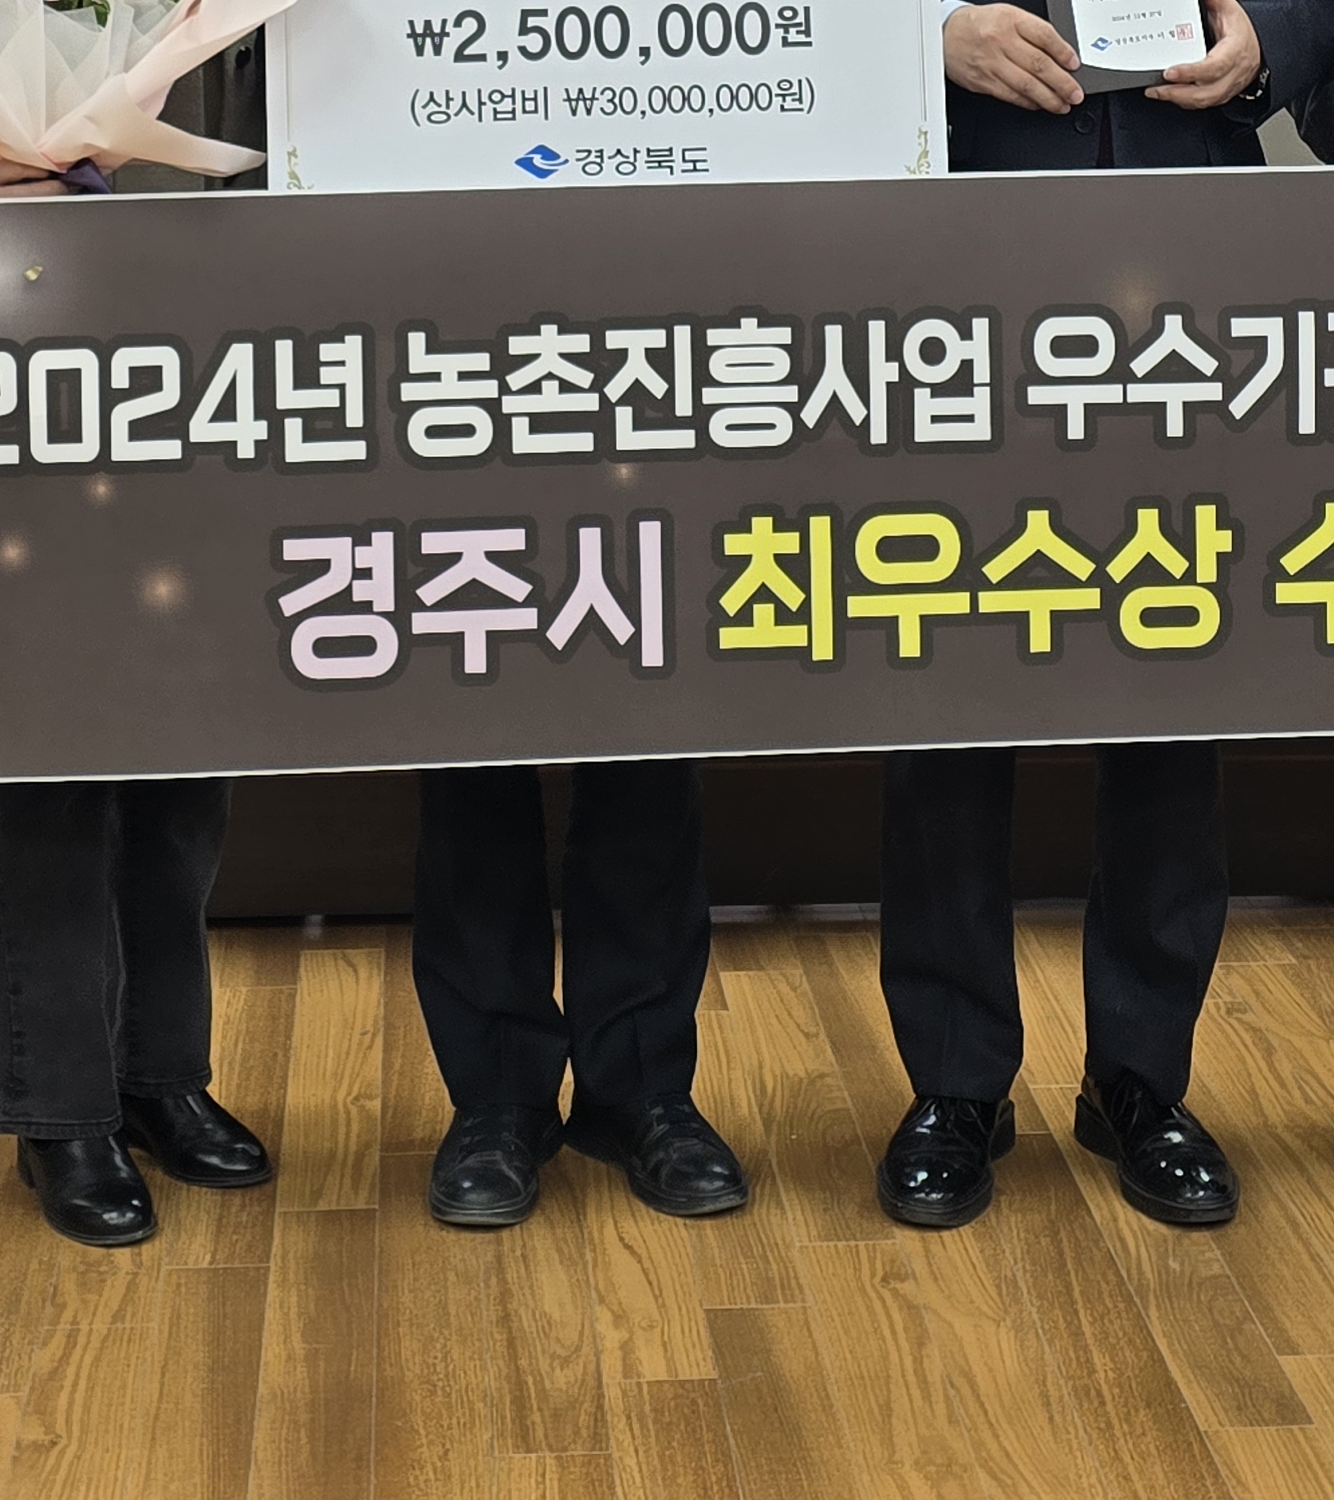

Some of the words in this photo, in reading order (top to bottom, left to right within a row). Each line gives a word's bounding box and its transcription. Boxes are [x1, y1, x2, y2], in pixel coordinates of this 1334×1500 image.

[411, 86, 548, 127] (상사업비
[563, 77, 814, 119] ₩30,000,000원)
[576, 147, 709, 176] 경상북도
[401, 318, 991, 457] 농촌진흥사업
[279, 521, 663, 679] 경주시
[719, 505, 1232, 661] 최우수상
